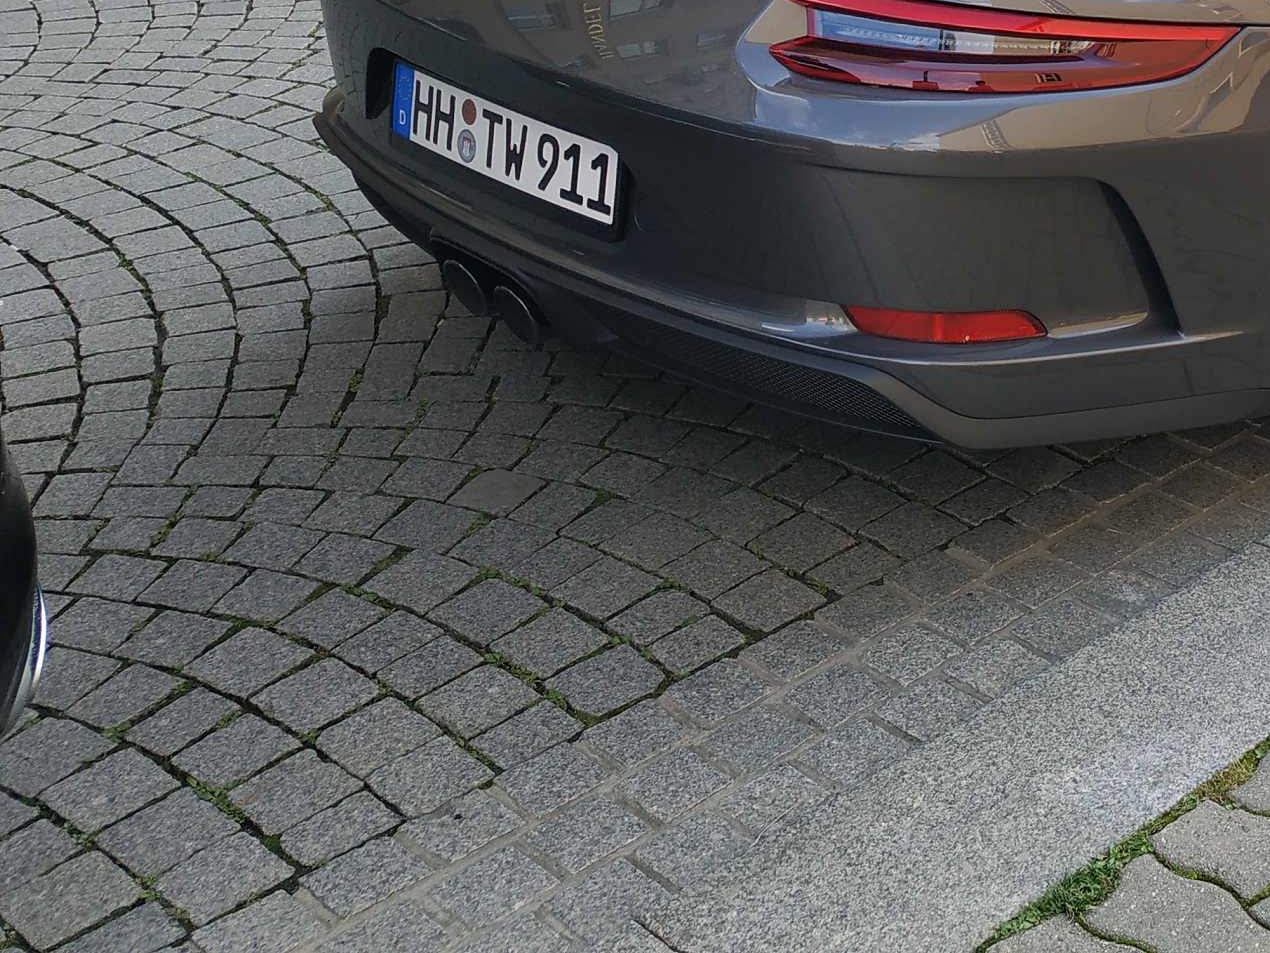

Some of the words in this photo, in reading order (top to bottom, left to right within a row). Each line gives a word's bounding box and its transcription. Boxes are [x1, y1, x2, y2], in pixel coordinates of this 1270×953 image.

[399, 109, 406, 126] D
[412, 79, 456, 152] HH
[482, 108, 528, 181] TW
[537, 133, 612, 216] 911
